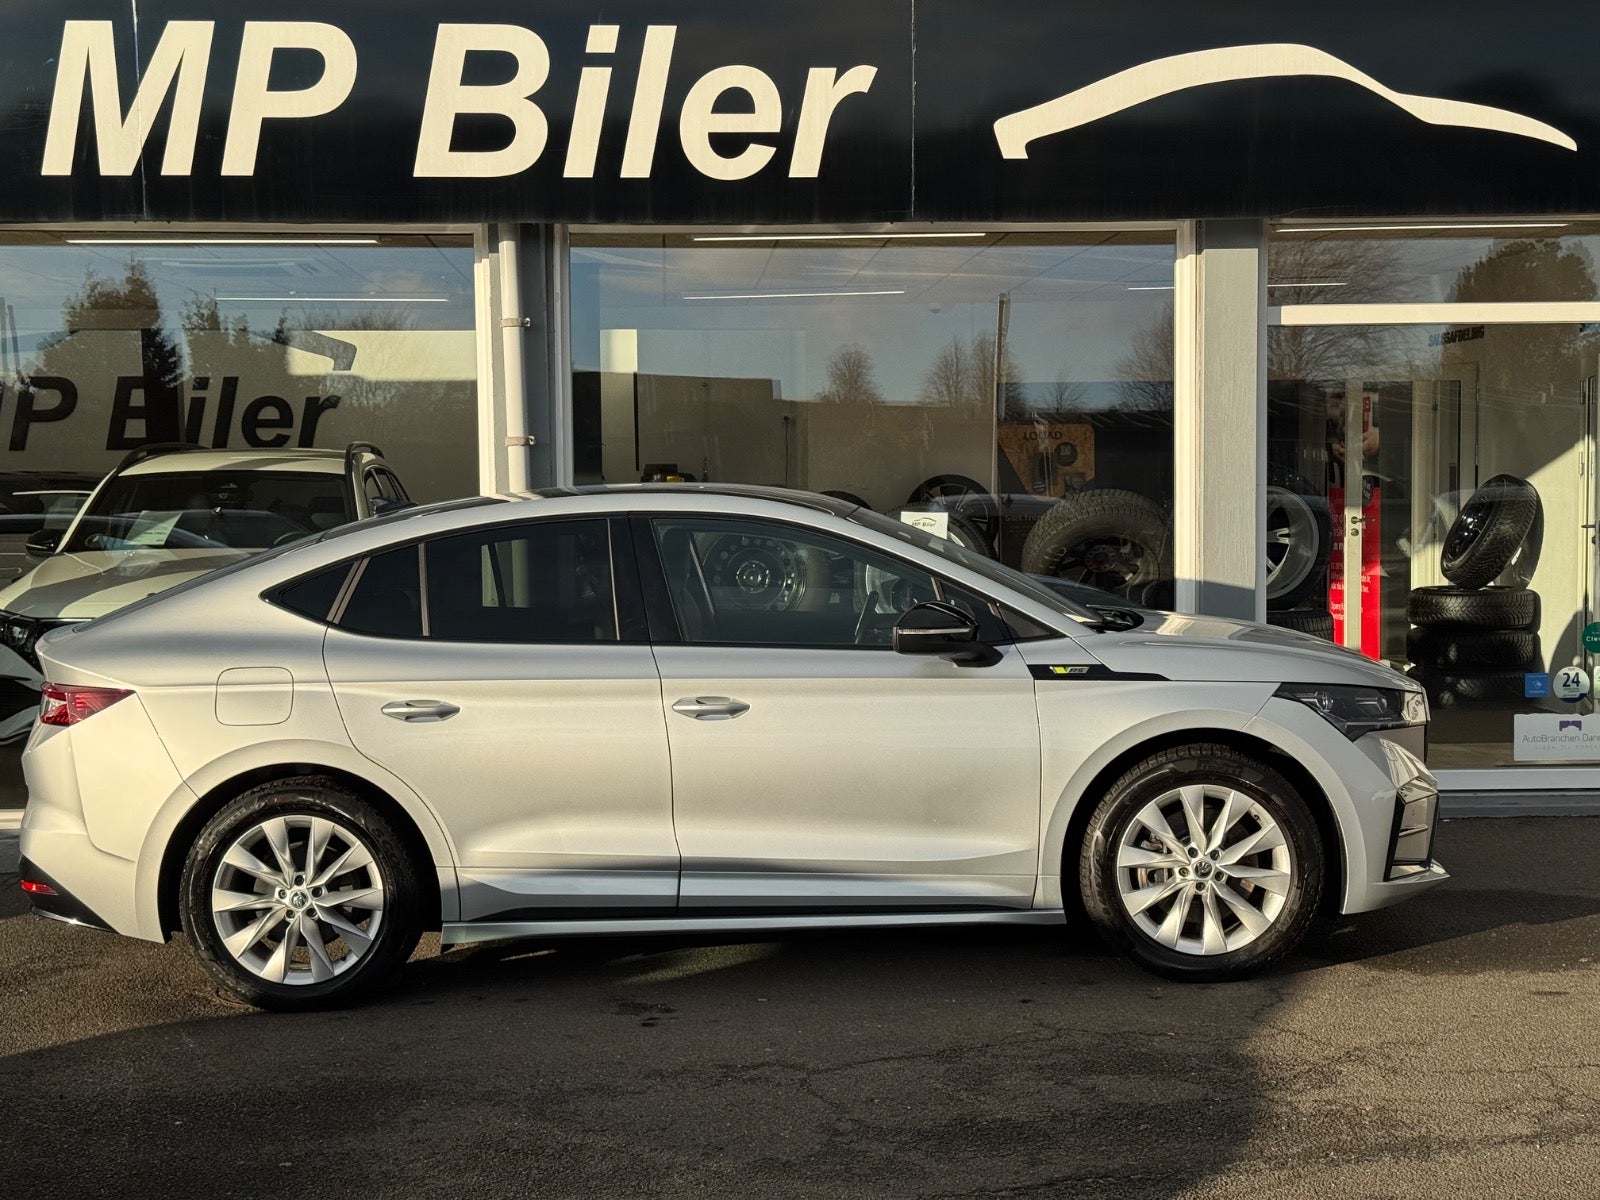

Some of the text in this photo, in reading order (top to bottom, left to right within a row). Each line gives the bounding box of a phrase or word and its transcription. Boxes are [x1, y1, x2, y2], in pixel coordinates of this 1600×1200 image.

[41, 20, 879, 182] MP Biler
[1562, 672, 1581, 688] 24
[1522, 734, 1580, 743] AutoBranchen
